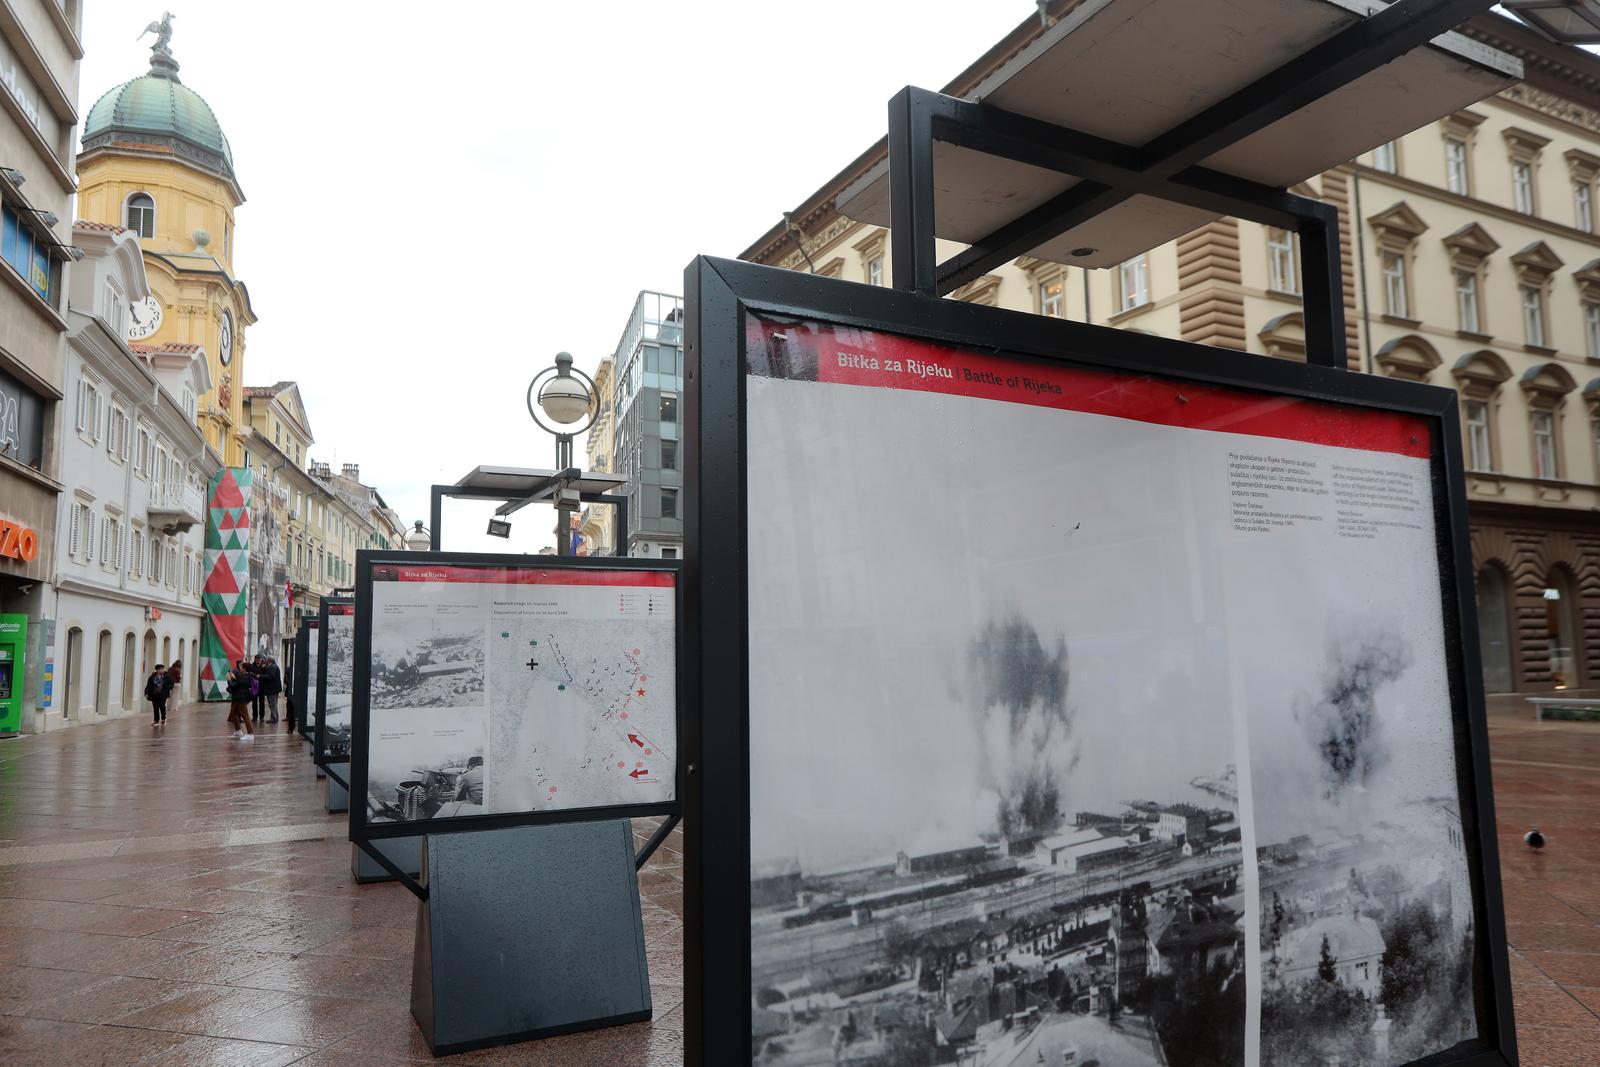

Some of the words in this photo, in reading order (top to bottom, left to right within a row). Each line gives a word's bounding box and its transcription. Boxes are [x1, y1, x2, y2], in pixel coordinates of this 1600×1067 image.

[152, 311, 160, 321] 3
[129, 327, 137, 338] 6
[139, 326, 146, 337] 5
[837, 352, 880, 370] Bitka
[884, 358, 903, 372] za
[906, 359, 953, 379] Rijeku
[963, 368, 1001, 386] Battle
[1006, 376, 1019, 388] of
[1023, 378, 1064, 395] Rijeka
[0, 518, 38, 563] ZO
